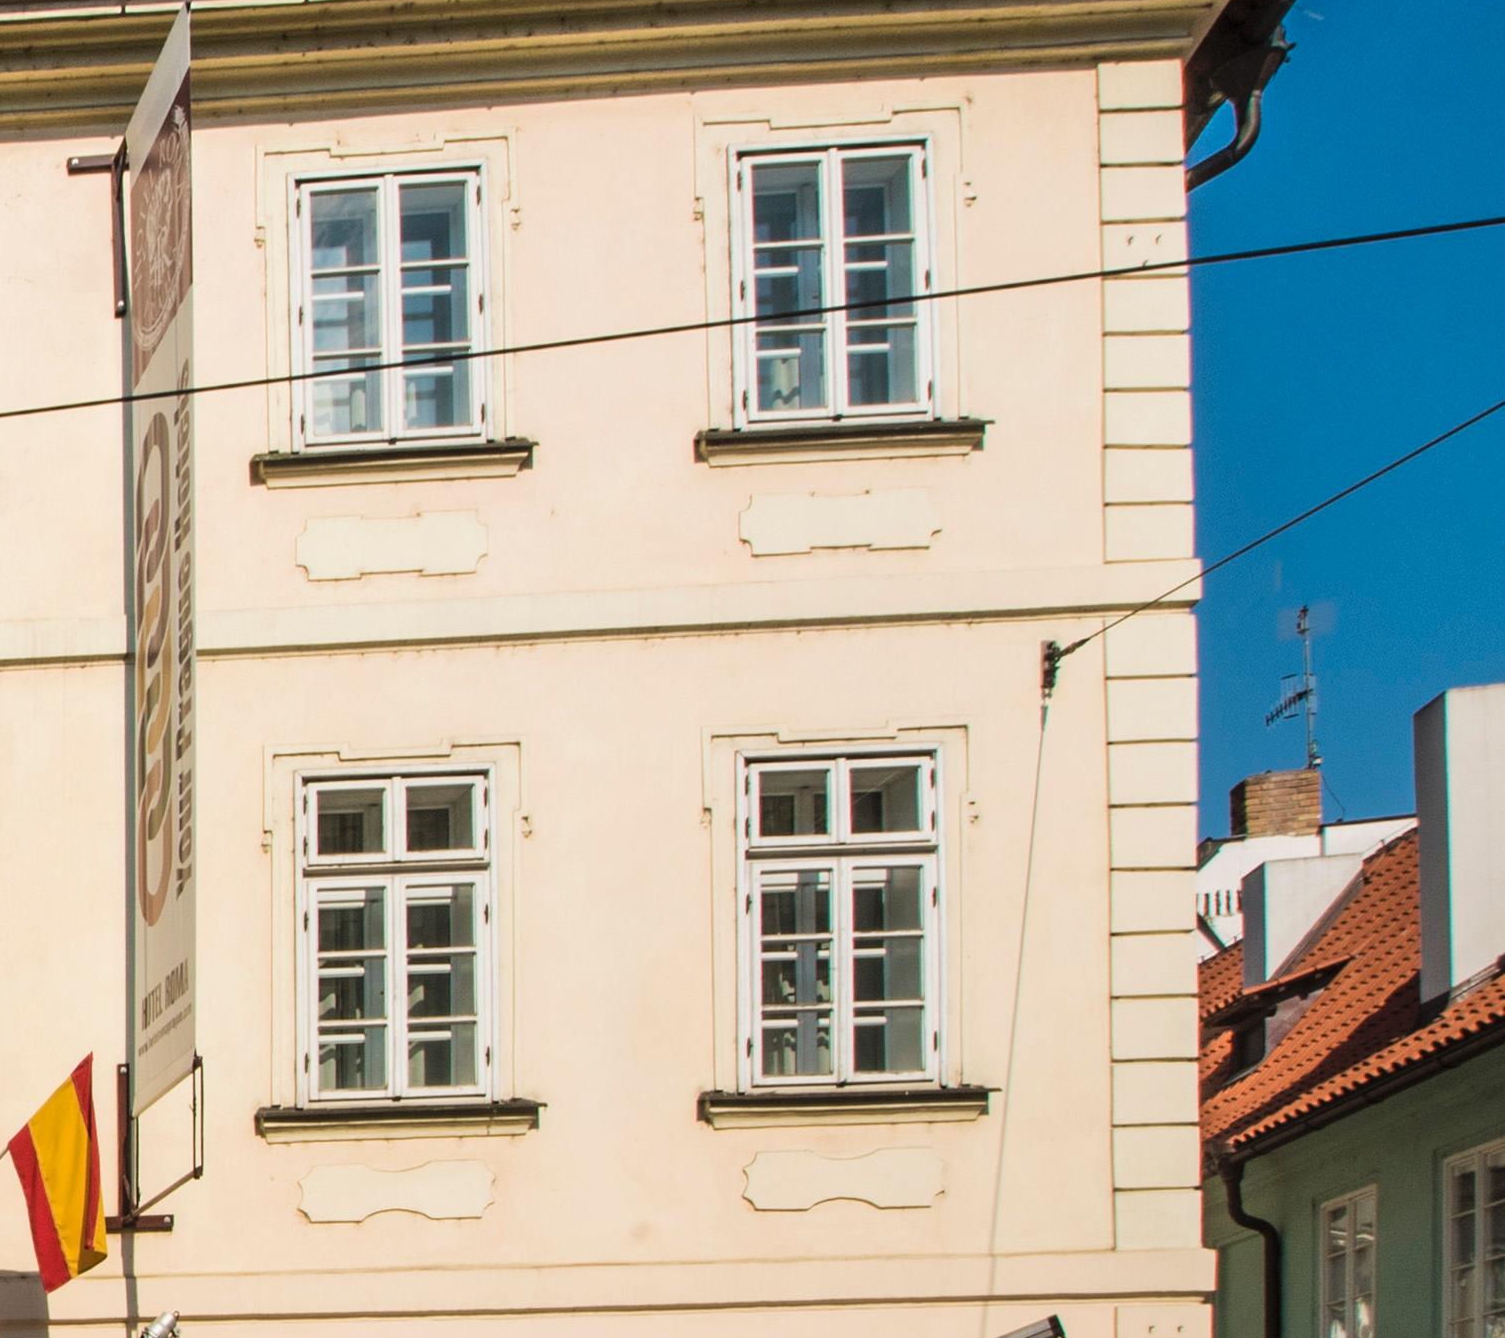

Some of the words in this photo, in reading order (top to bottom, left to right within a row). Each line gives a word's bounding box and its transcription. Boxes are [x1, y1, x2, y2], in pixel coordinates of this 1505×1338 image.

[173, 358, 191, 551] Hotels
[175, 552, 193, 762] Prague
[175, 768, 193, 899] Your
